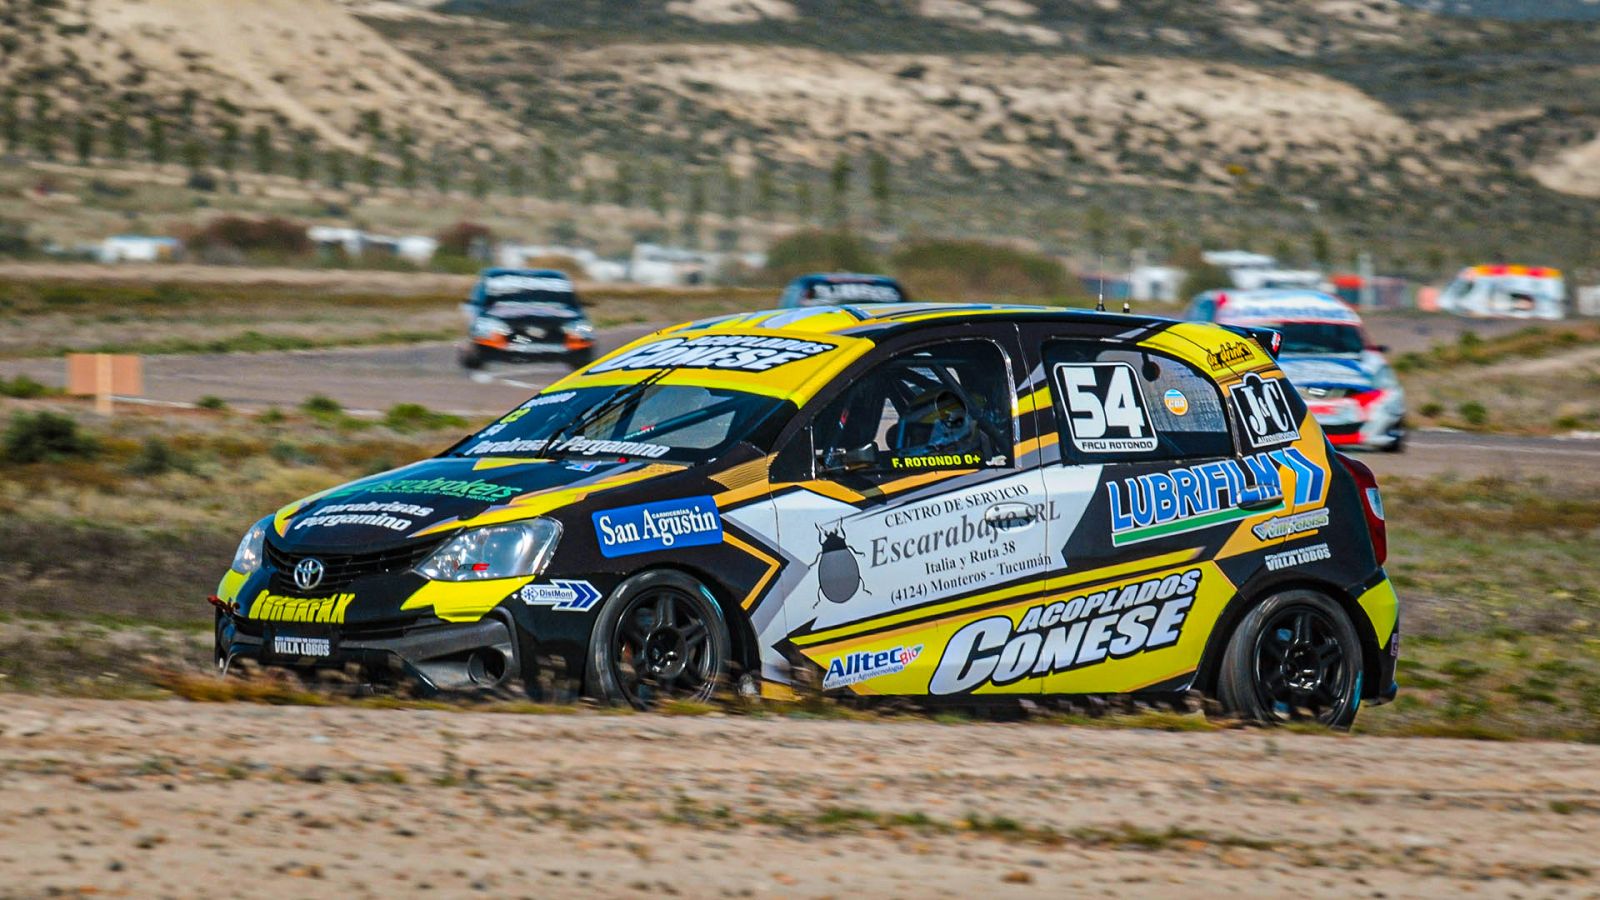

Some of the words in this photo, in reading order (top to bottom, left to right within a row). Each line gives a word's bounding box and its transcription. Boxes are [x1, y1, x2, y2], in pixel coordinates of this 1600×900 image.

[588, 338, 808, 371] CONESE
[1063, 366, 1144, 438] 54
[557, 436, 670, 458] Pergamino
[892, 458, 903, 468] F.
[905, 455, 961, 467] ROTONDO
[1082, 441, 1107, 450] FACU
[1109, 440, 1153, 449] ROTONDO
[885, 505, 941, 528] CENTRO
[945, 500, 963, 516] DE
[966, 484, 1029, 508] SERVICIO
[1107, 451, 1282, 532] LUBRIFILM
[600, 515, 640, 545] San
[870, 511, 1019, 568] Escarabajo
[1022, 500, 1061, 527] SRL
[925, 557, 956, 575] Italia
[960, 556, 967, 568] y
[970, 547, 999, 565] Ruta
[1002, 541, 1016, 556] 38
[1266, 555, 1297, 571] VILLA
[1297, 548, 1331, 564] LOBOS
[540, 589, 573, 599] DistMont
[890, 585, 928, 605] (4124)
[931, 572, 987, 594] Monteros
[997, 554, 1051, 577] Tucumán
[1016, 570, 1200, 633] ACOPLADOS
[275, 641, 299, 655] VILLA
[301, 642, 330, 656] LOBOS
[930, 597, 1194, 695] CONESE
[825, 647, 903, 681] Alltec
